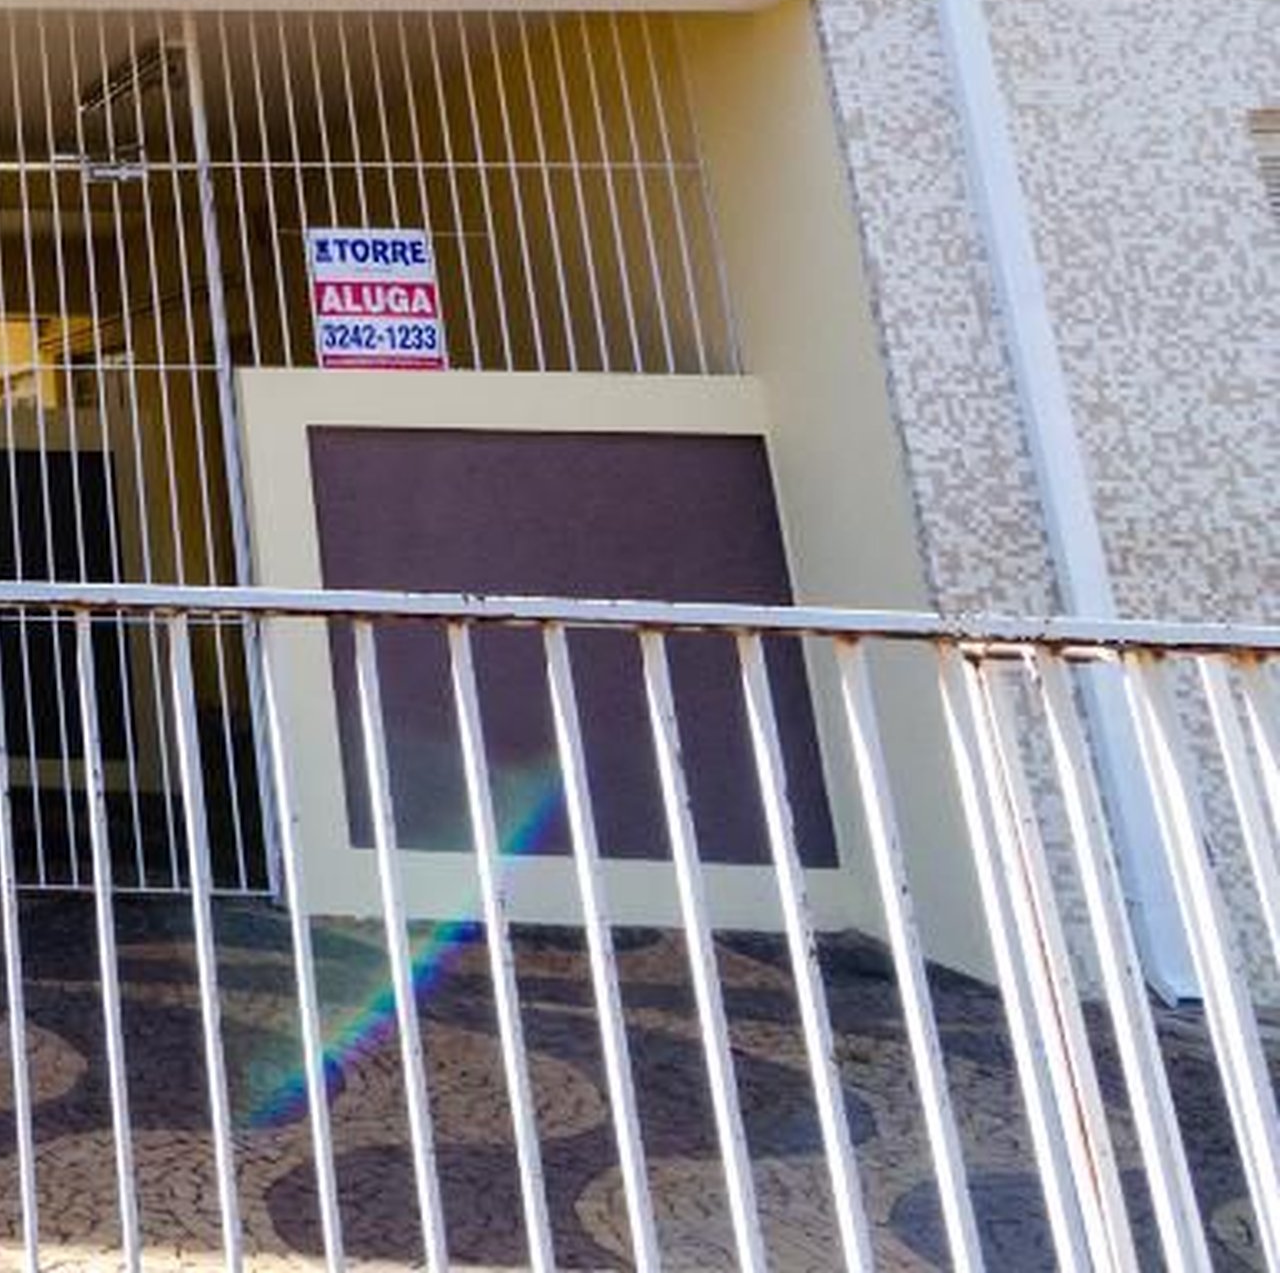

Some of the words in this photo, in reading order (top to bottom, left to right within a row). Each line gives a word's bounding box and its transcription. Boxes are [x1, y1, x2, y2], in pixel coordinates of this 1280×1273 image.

[333, 238, 427, 266] TORRE
[321, 284, 433, 314] ALUGA
[323, 324, 437, 350] 3242-1233
